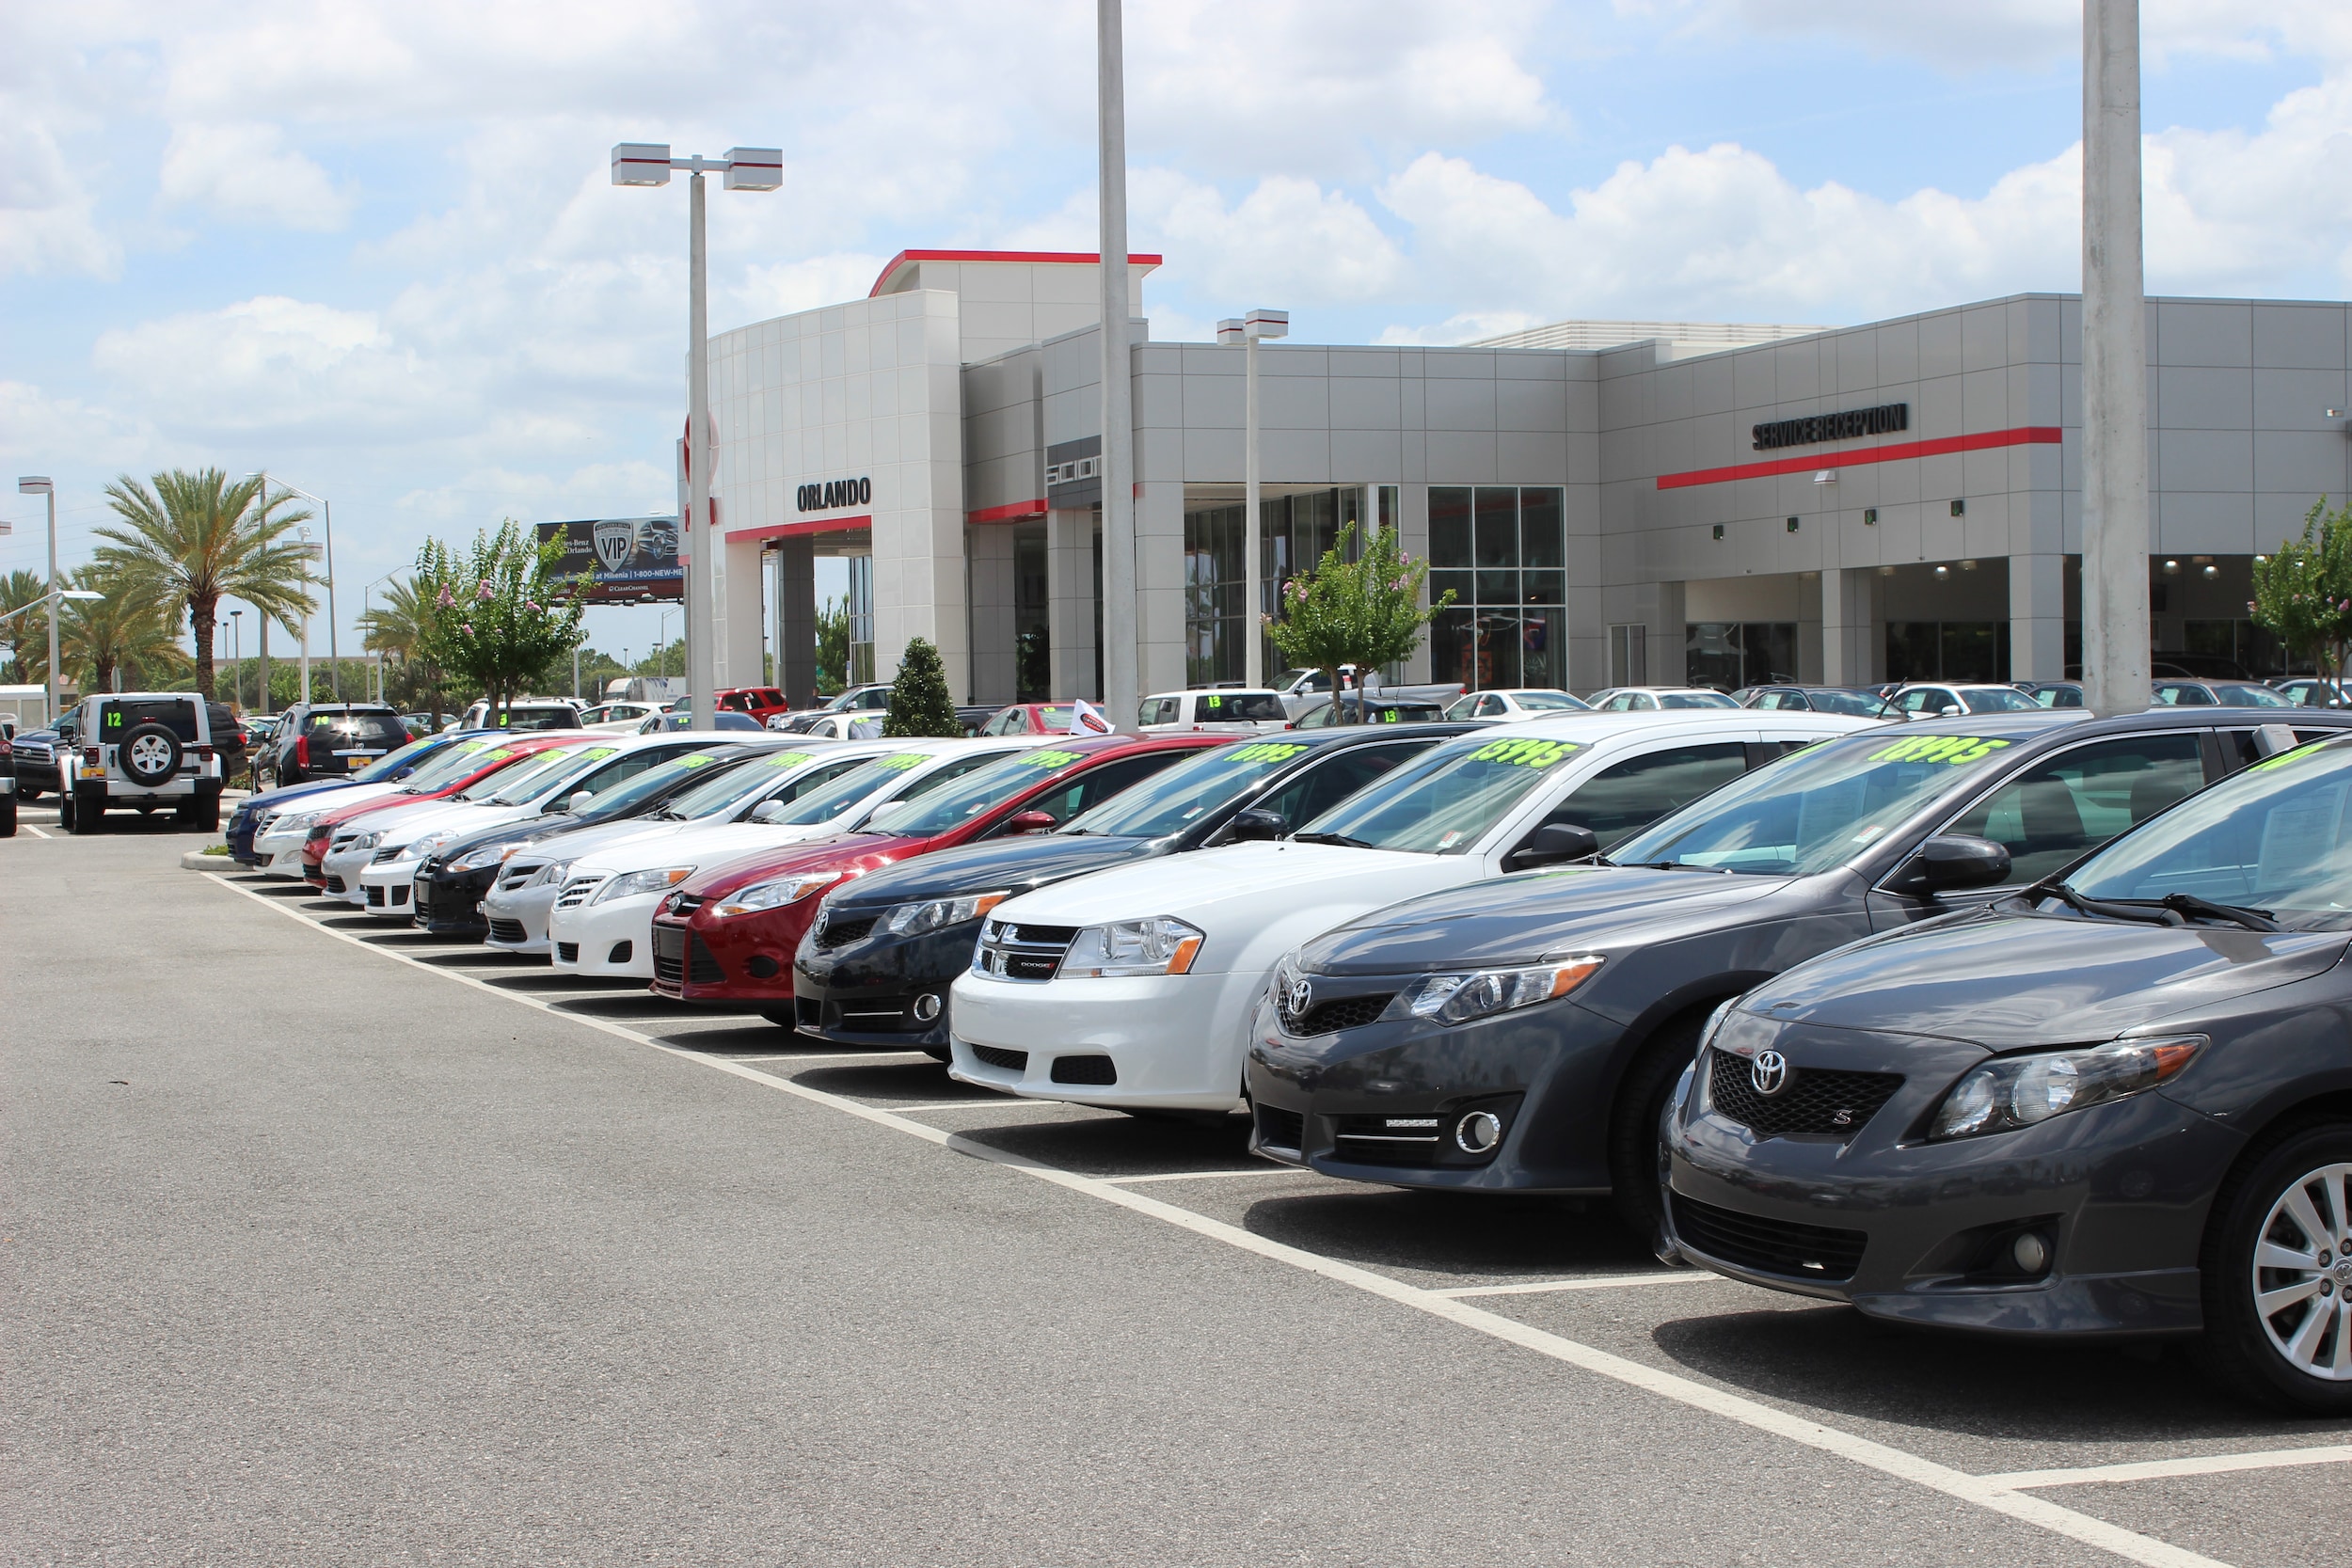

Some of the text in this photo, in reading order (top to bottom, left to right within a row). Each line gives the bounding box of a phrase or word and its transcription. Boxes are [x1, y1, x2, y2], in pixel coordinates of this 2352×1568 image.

[1753, 404, 1908, 451] SERVICE RECEPTION
[797, 477, 871, 512] ORLANDO
[567, 546, 593, 554] Orlando
[600, 537, 627, 561] VIP
[1208, 695, 1221, 708] 13
[107, 712, 121, 727] 12
[499, 713, 508, 727] 3
[1384, 710, 1397, 722] 13
[1222, 743, 1310, 763] 16995
[1467, 738, 1580, 768] 15995
[1867, 736, 2010, 765] 18995
[1833, 1109, 1852, 1124] S
